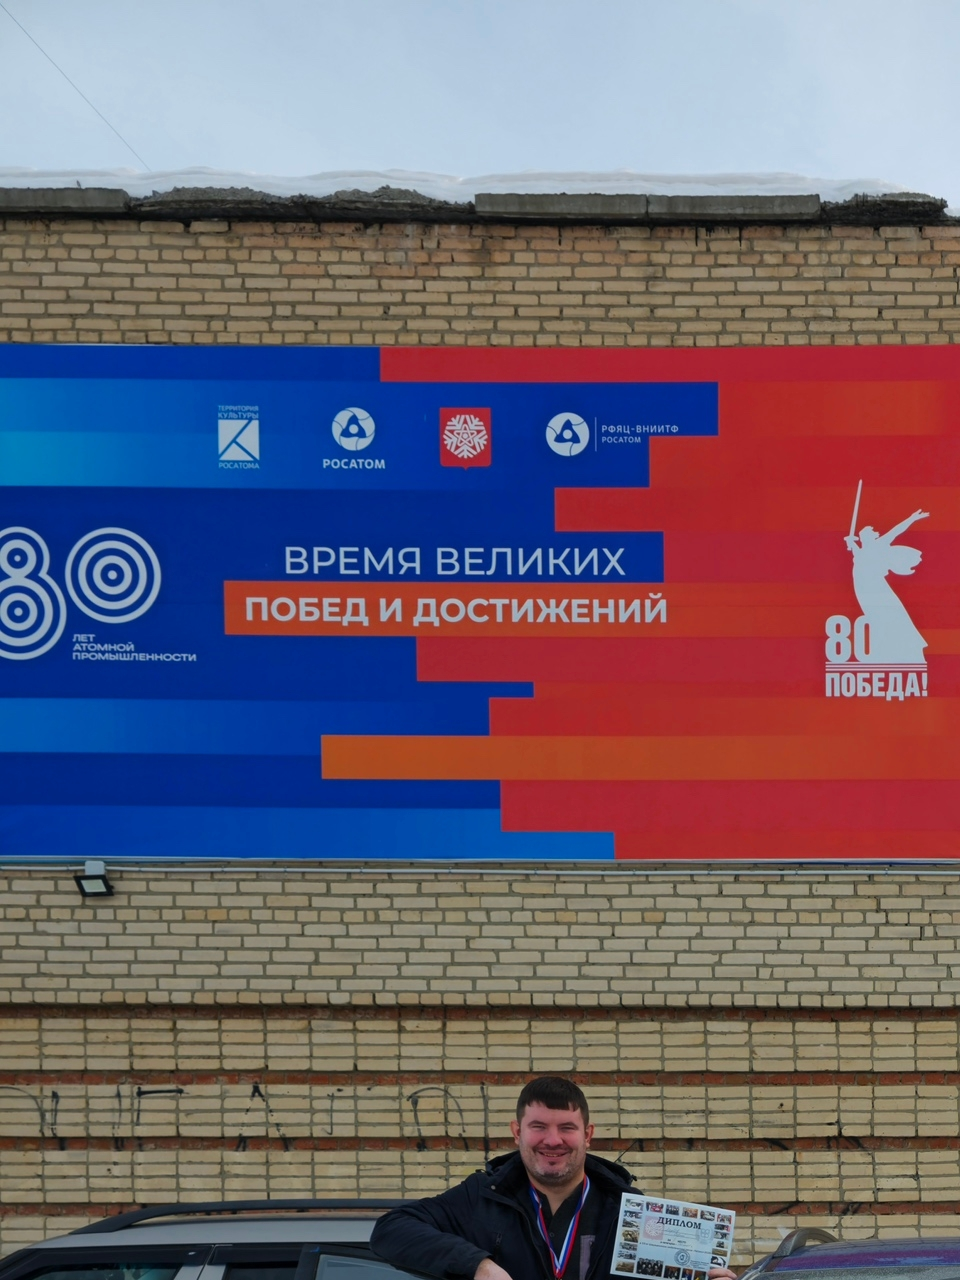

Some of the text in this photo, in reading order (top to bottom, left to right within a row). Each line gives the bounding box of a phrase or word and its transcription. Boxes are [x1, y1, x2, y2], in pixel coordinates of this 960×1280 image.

[601, 423, 679, 435] РФЯЦ-ВНИИТФ
[601, 436, 641, 444] РОСАТОМ
[323, 458, 386, 469] РОСАТОМ
[285, 546, 626, 577] ВРЕМЯ ВЕЛИКИХ
[245, 592, 668, 627] ПОБЕД И ДОСТИЖЕНИЙ
[72, 634, 96, 642] ЛЕТ
[825, 615, 872, 663] 80
[73, 642, 135, 651] АТОМНОЙ
[72, 652, 197, 661] ПРОМЫШЛЕННОСТИ
[825, 672, 928, 701] ПОБЕДА!
[656, 1216, 701, 1230] ДИПЛОМ
